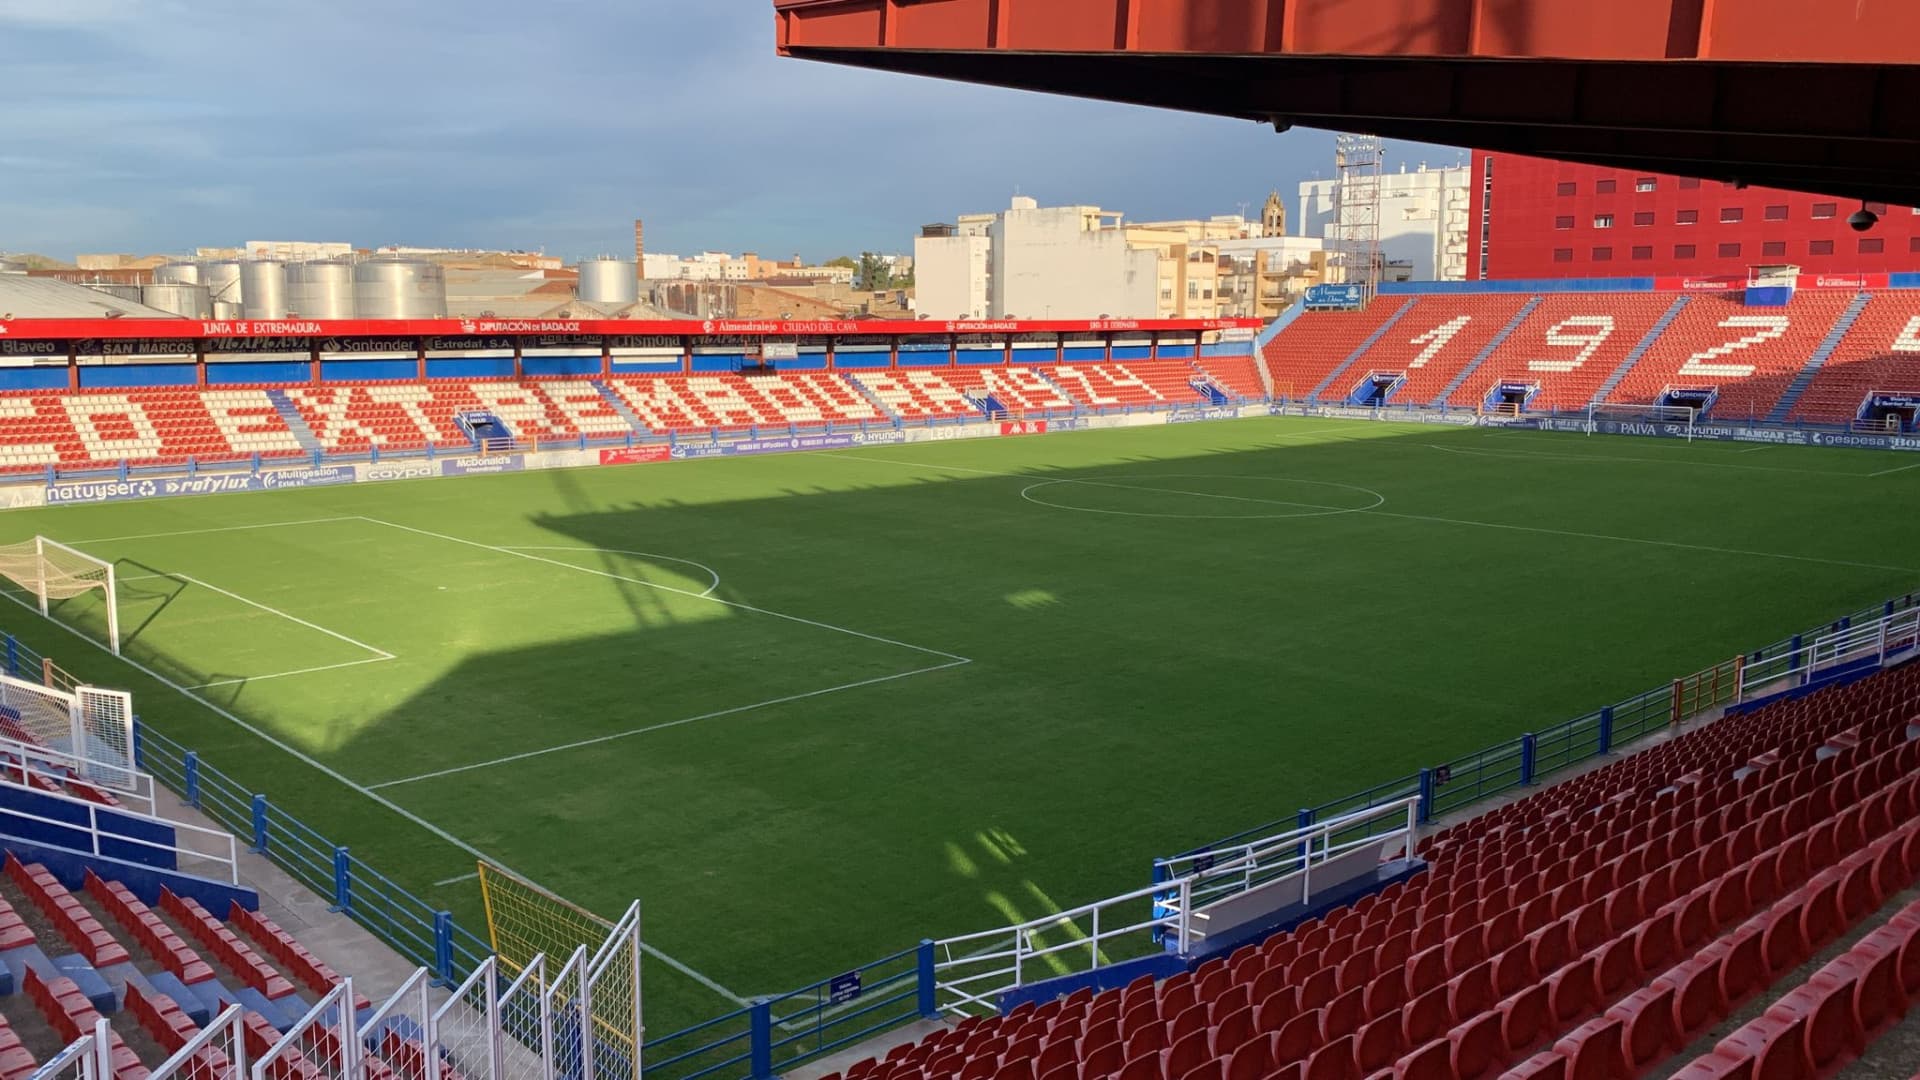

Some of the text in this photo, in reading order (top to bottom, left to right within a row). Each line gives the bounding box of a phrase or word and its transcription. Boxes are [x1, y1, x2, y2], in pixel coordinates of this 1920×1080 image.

[203, 322, 321, 335] JUNTA DE EXTREMADURA
[480, 321, 531, 331] DIPUTACIÓN
[541, 322, 579, 331] BADAJOZ
[719, 321, 777, 333] Almendralejo
[783, 321, 817, 331] CIUDAD
[819, 321, 834, 331] DEL
[103, 343, 132, 354] SAN
[139, 342, 195, 354] MARCOS
[344, 339, 414, 351] Santander
[1582, 420, 1598, 432] vt
[1621, 422, 1656, 435] PAIVA
[1684, 421, 1732, 436] HYUNDAI
[867, 431, 904, 440] HYUNDAI
[1825, 435, 1885, 447] gespesa
[456, 456, 511, 467] McDonald's
[368, 468, 431, 480] caypa
[47, 481, 137, 500] natuyser
